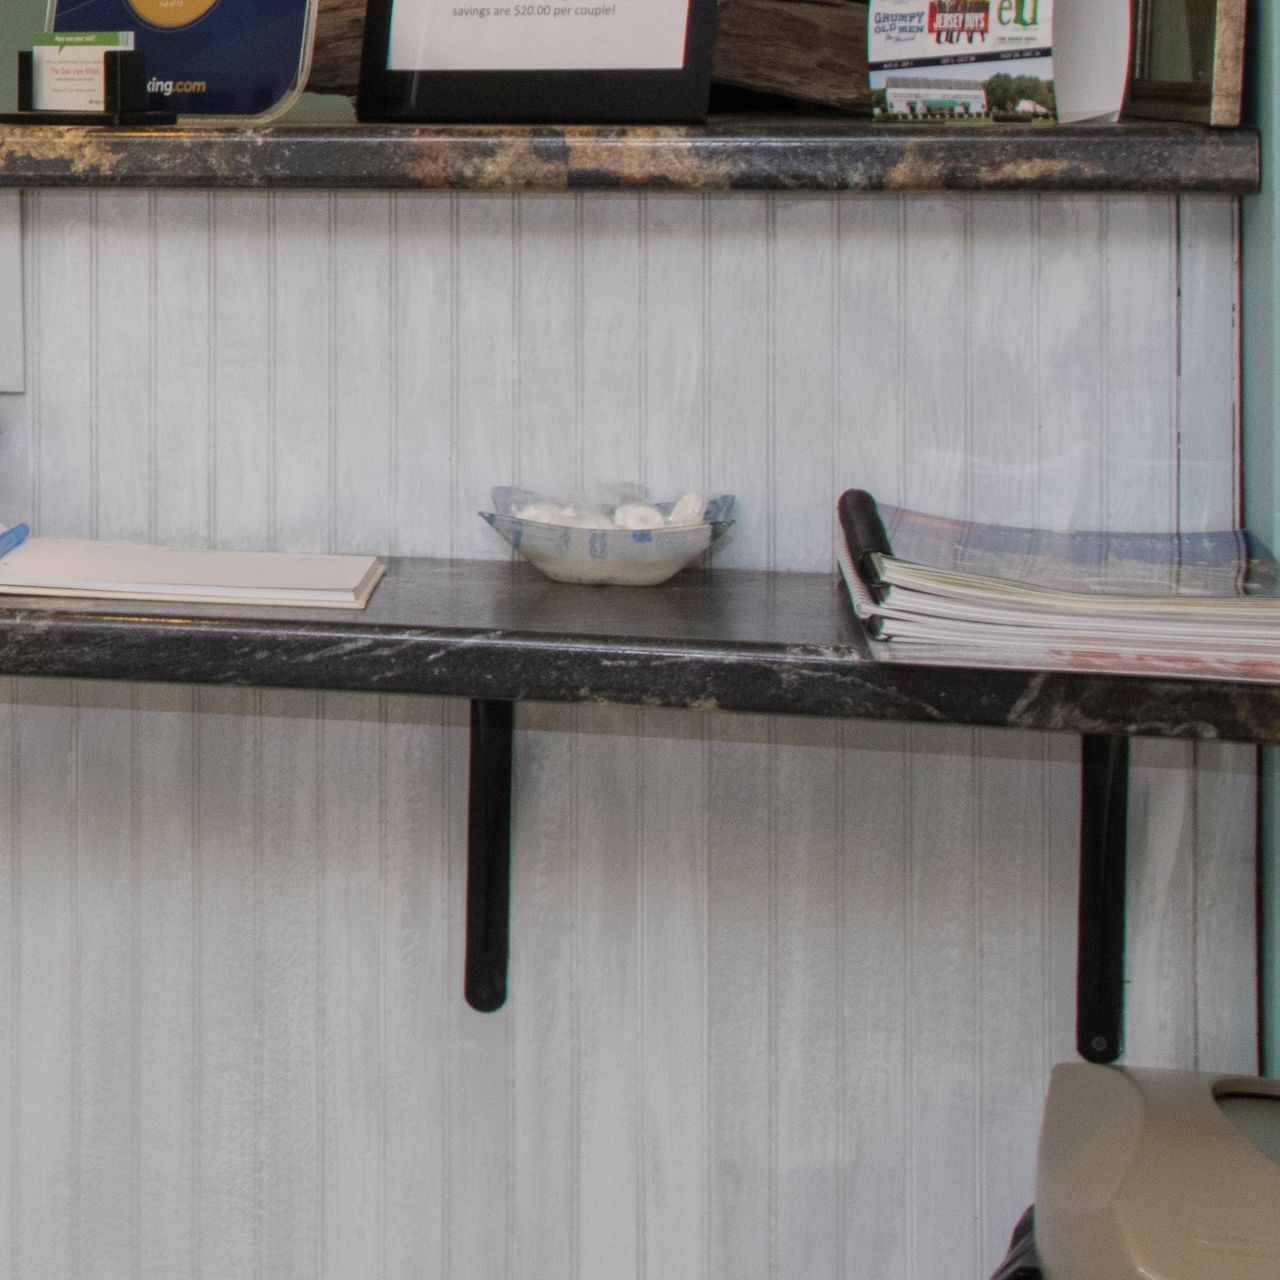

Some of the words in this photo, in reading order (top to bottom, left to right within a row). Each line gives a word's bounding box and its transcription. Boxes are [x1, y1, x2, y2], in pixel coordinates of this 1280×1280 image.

[452, 6, 490, 18] savings
[493, 7, 511, 16] are
[514, 4, 551, 17] $20.00
[553, 7, 572, 18] per
[574, 4, 616, 17] couple!
[874, 11, 925, 23] GRUMPY
[933, 13, 963, 30] JERSEY
[964, 12, 985, 29] BOYS
[874, 23, 897, 34] OLD
[898, 25, 924, 33] MEN
